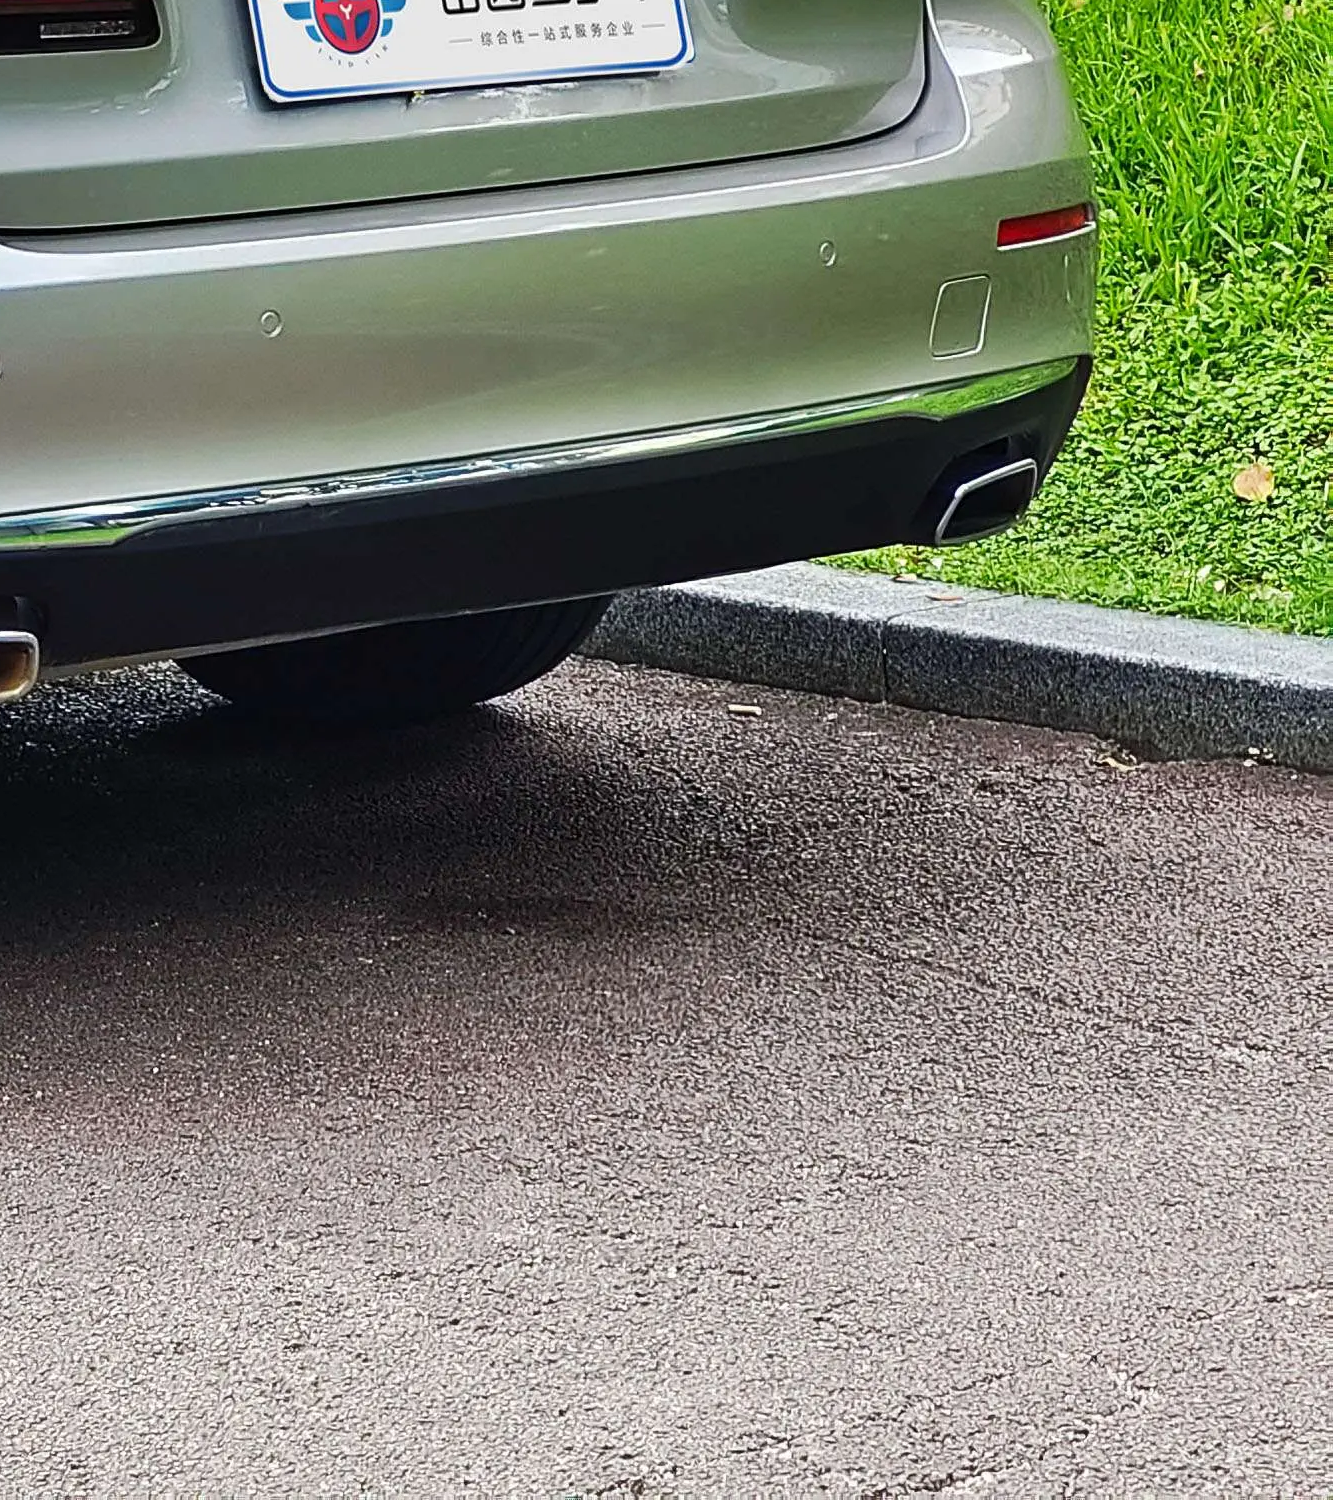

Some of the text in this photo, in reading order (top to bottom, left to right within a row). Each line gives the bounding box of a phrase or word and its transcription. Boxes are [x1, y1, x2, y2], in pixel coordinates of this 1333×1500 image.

[480, 21, 634, 47] 综合性一站式服务企业
